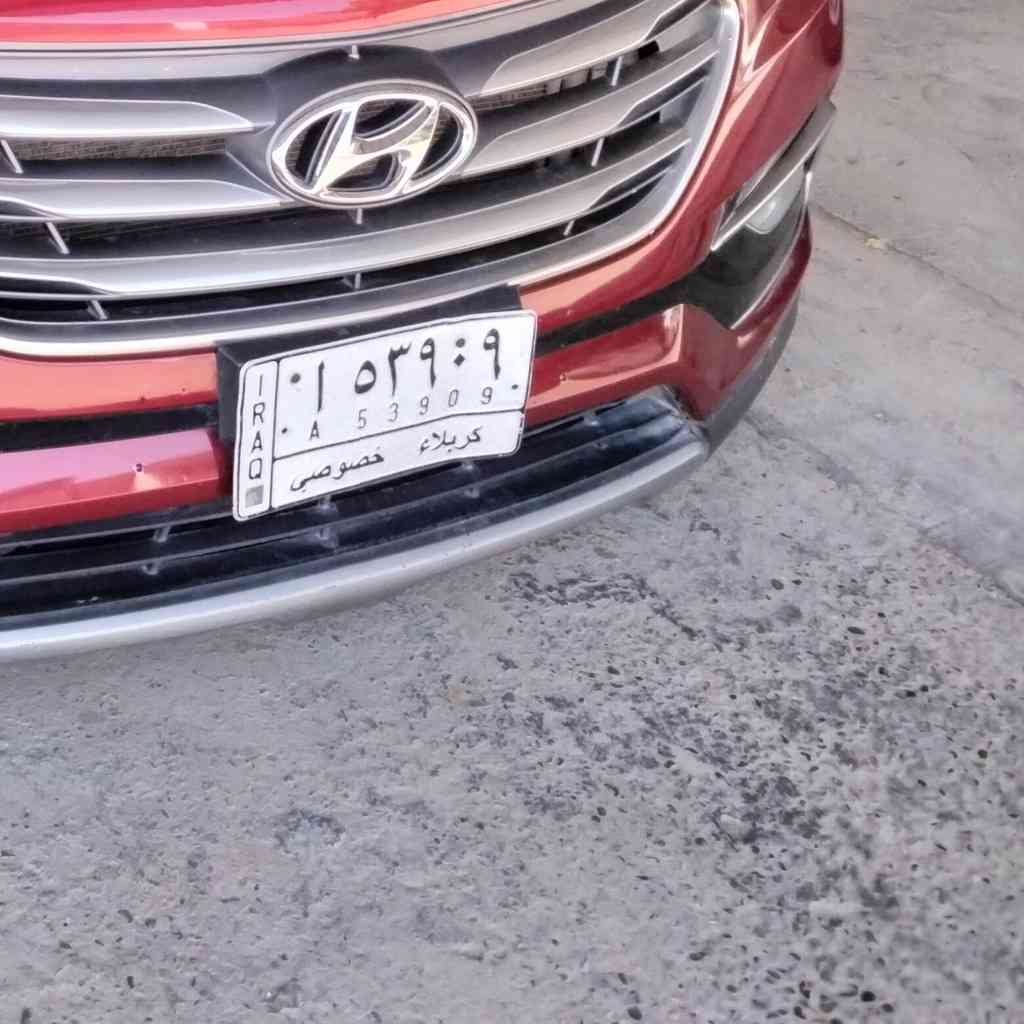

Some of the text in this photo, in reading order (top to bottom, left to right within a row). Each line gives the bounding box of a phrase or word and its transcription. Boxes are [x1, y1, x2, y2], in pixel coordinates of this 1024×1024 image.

[248, 373, 266, 480] IRAQ
[290, 425, 482, 492] كربلاء خصوصي
